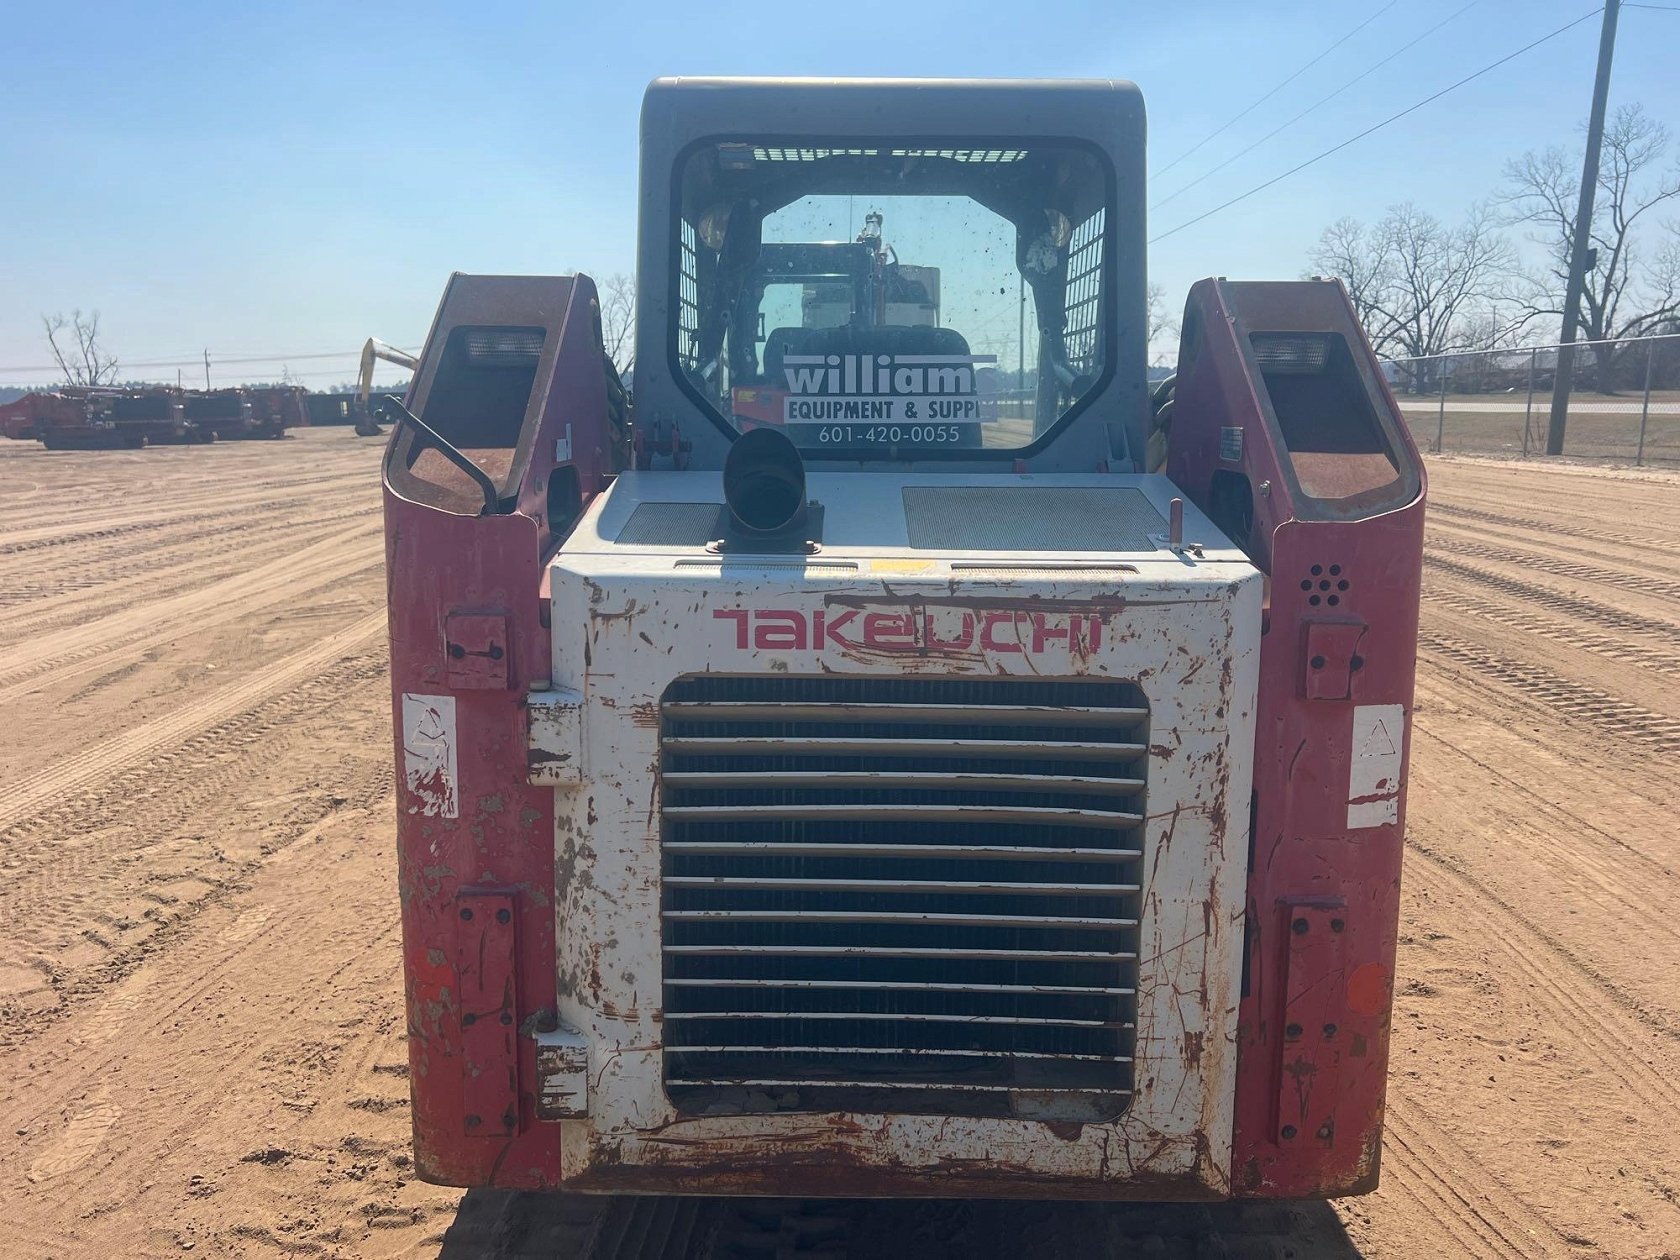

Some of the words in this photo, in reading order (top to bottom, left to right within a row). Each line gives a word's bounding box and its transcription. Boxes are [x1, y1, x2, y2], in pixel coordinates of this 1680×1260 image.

[783, 354, 997, 394] william
[788, 400, 894, 419] EQUIPMENT
[904, 401, 918, 418] &
[818, 425, 960, 443] 601-420-0055
